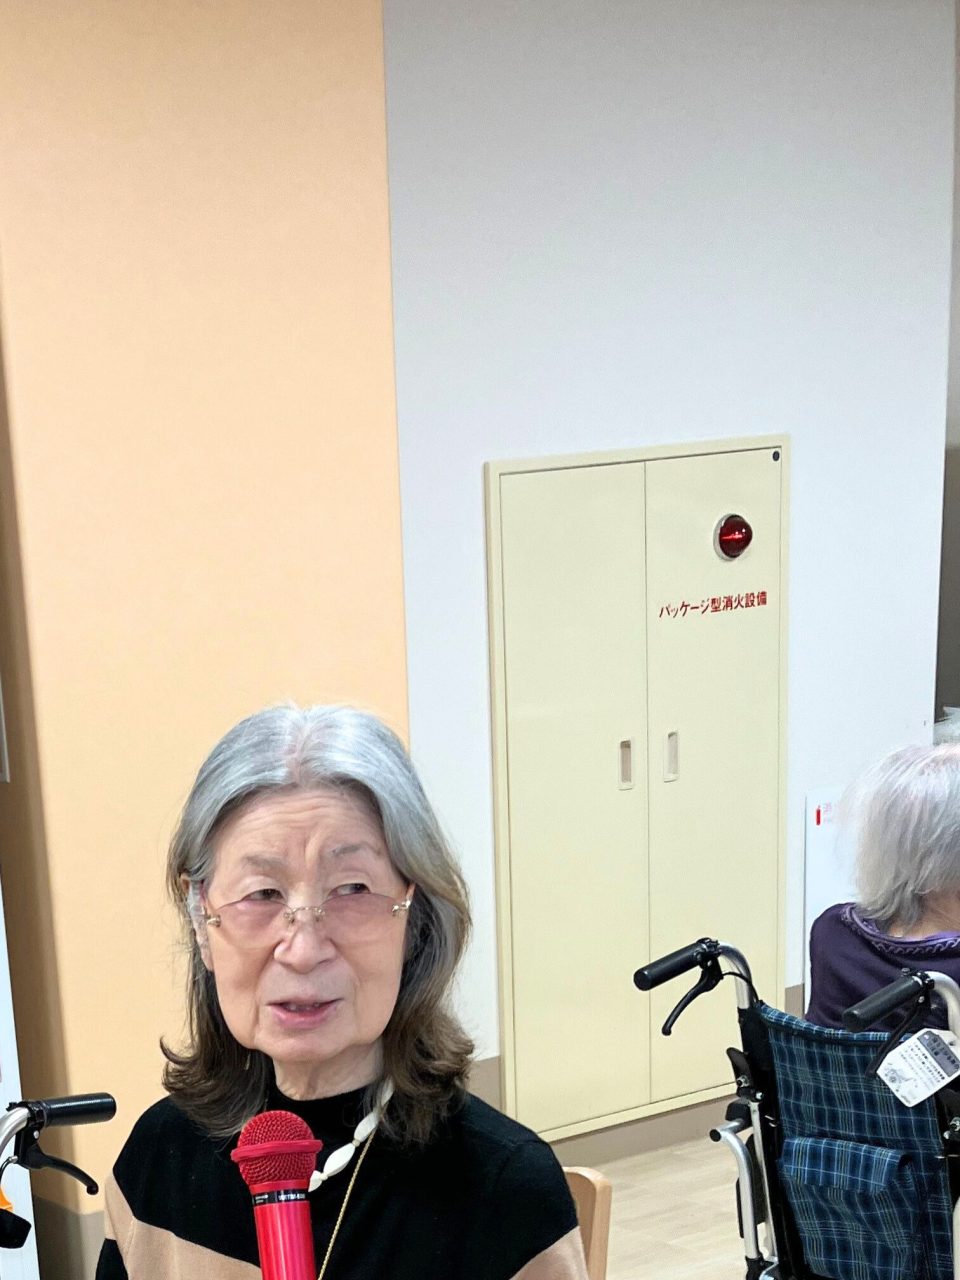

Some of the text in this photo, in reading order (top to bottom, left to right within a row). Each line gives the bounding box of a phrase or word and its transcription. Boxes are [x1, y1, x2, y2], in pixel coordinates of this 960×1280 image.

[659, 591, 768, 619] パッケージ型消火設備
